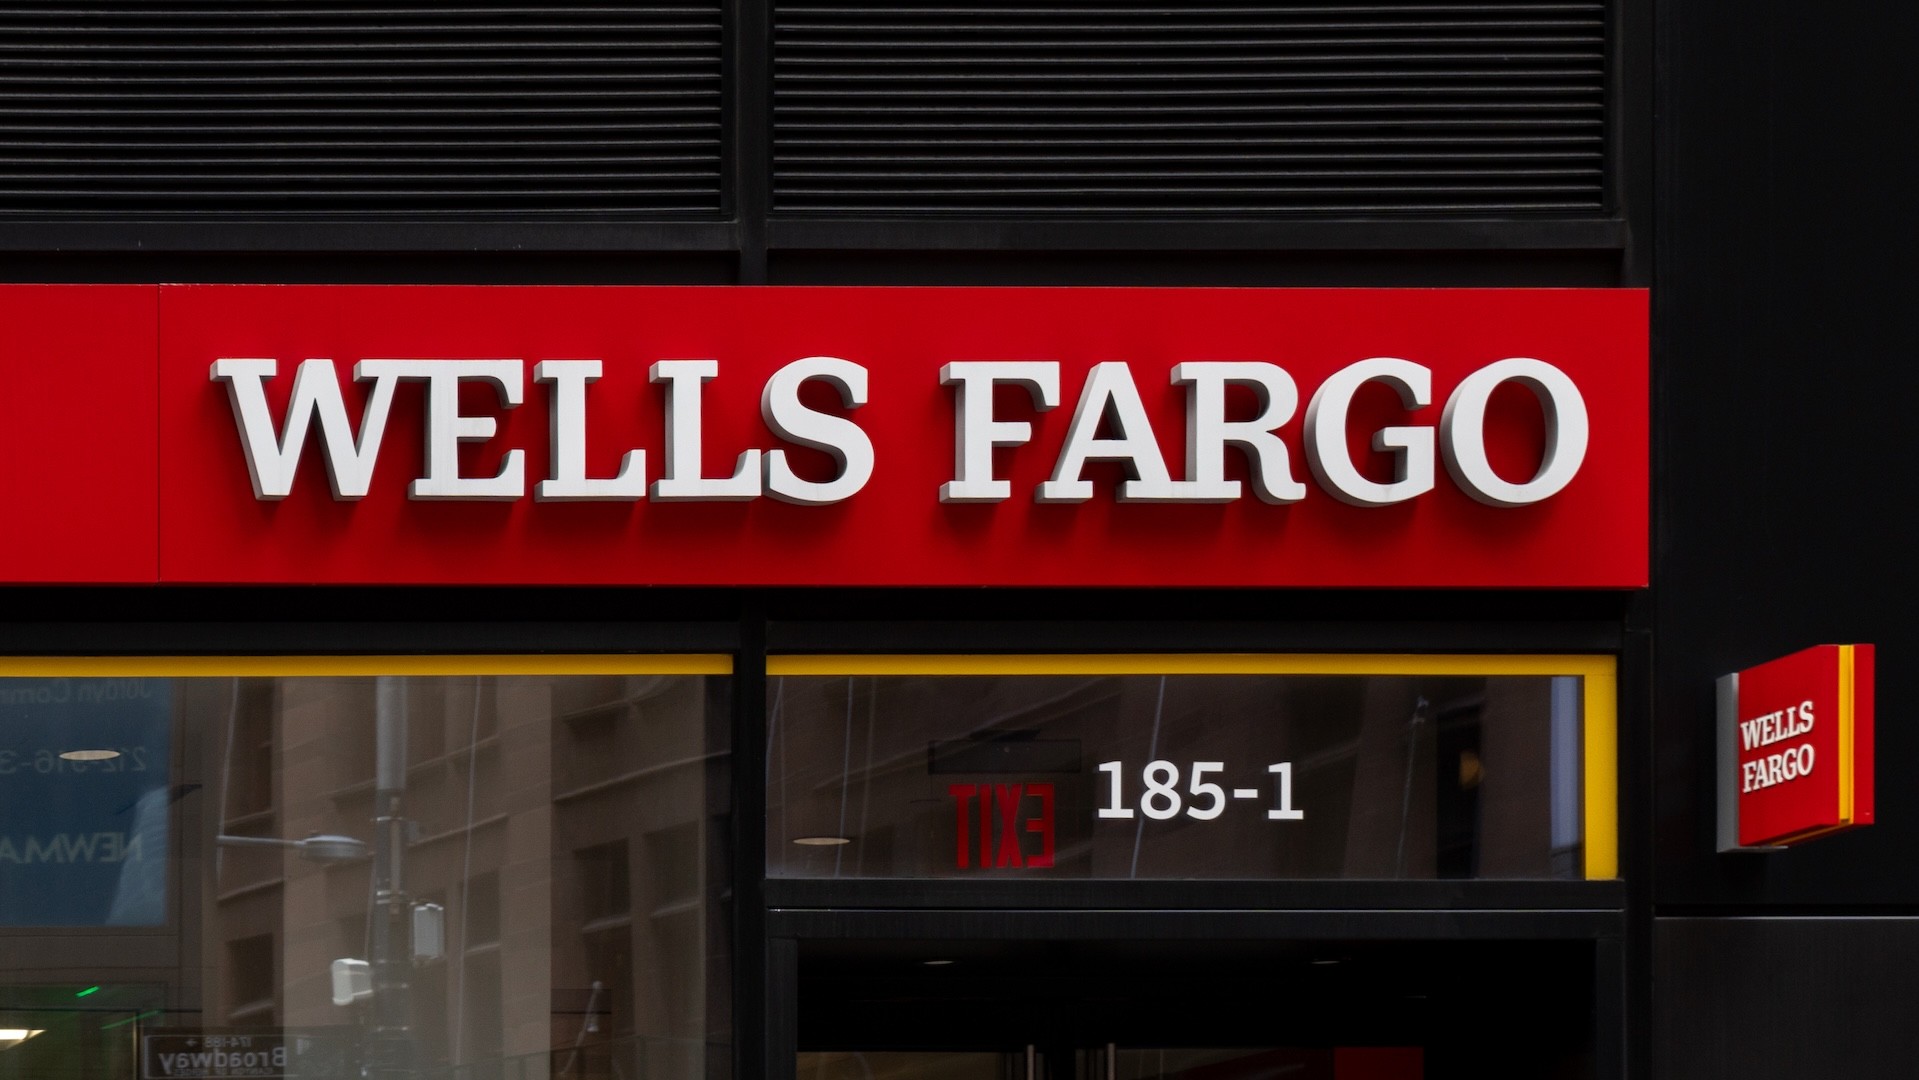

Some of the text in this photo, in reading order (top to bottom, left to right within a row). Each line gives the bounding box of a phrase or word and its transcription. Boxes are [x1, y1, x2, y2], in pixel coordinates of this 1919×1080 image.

[210, 356, 1589, 507] WELLS FARGO
[1740, 700, 1815, 751] WELLS
[1098, 760, 1304, 820] 185-1
[1742, 743, 1815, 793] FARGO
